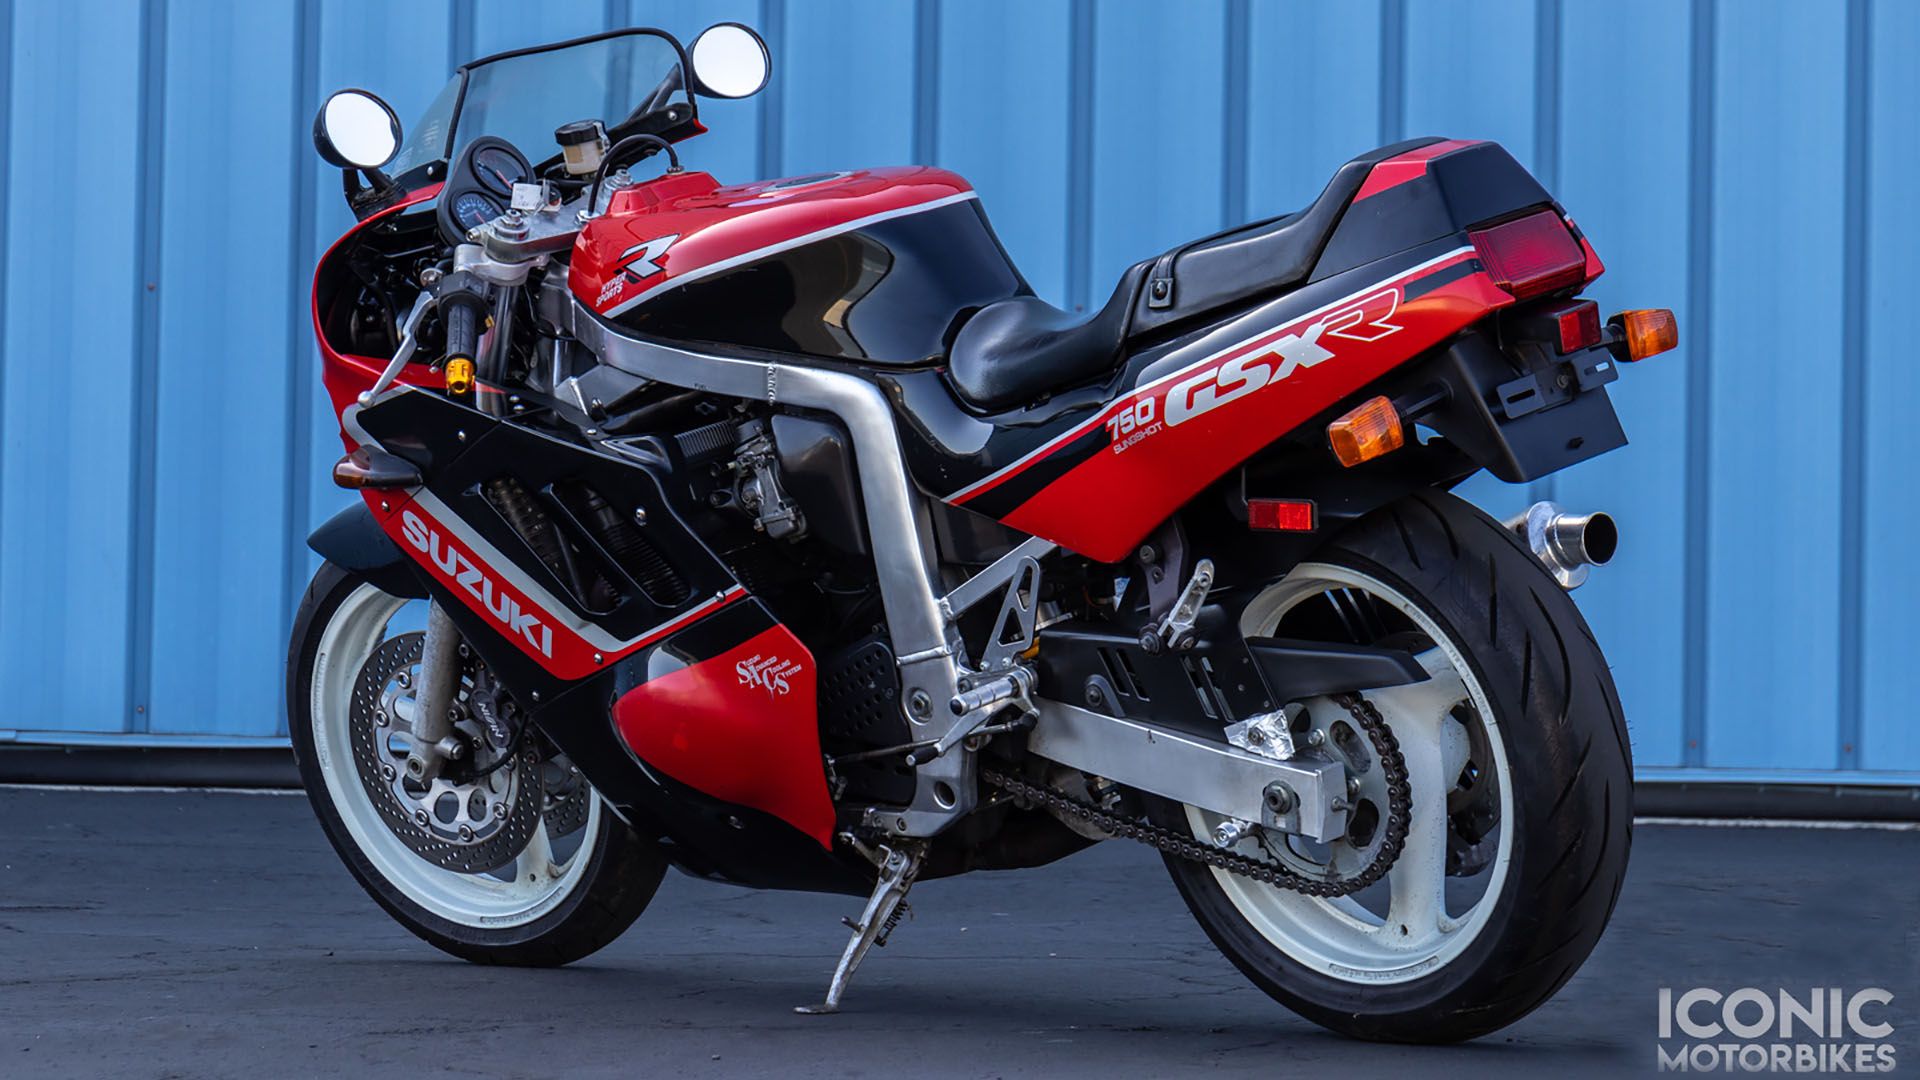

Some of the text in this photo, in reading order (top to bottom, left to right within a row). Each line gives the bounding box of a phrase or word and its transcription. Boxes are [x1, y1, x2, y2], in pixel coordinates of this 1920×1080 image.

[595, 283, 623, 307] SPORTS
[601, 271, 627, 293] HYPER
[1106, 394, 1155, 442] 750
[1112, 421, 1164, 455] SLINGSHOT
[401, 509, 553, 660] SUZUKI
